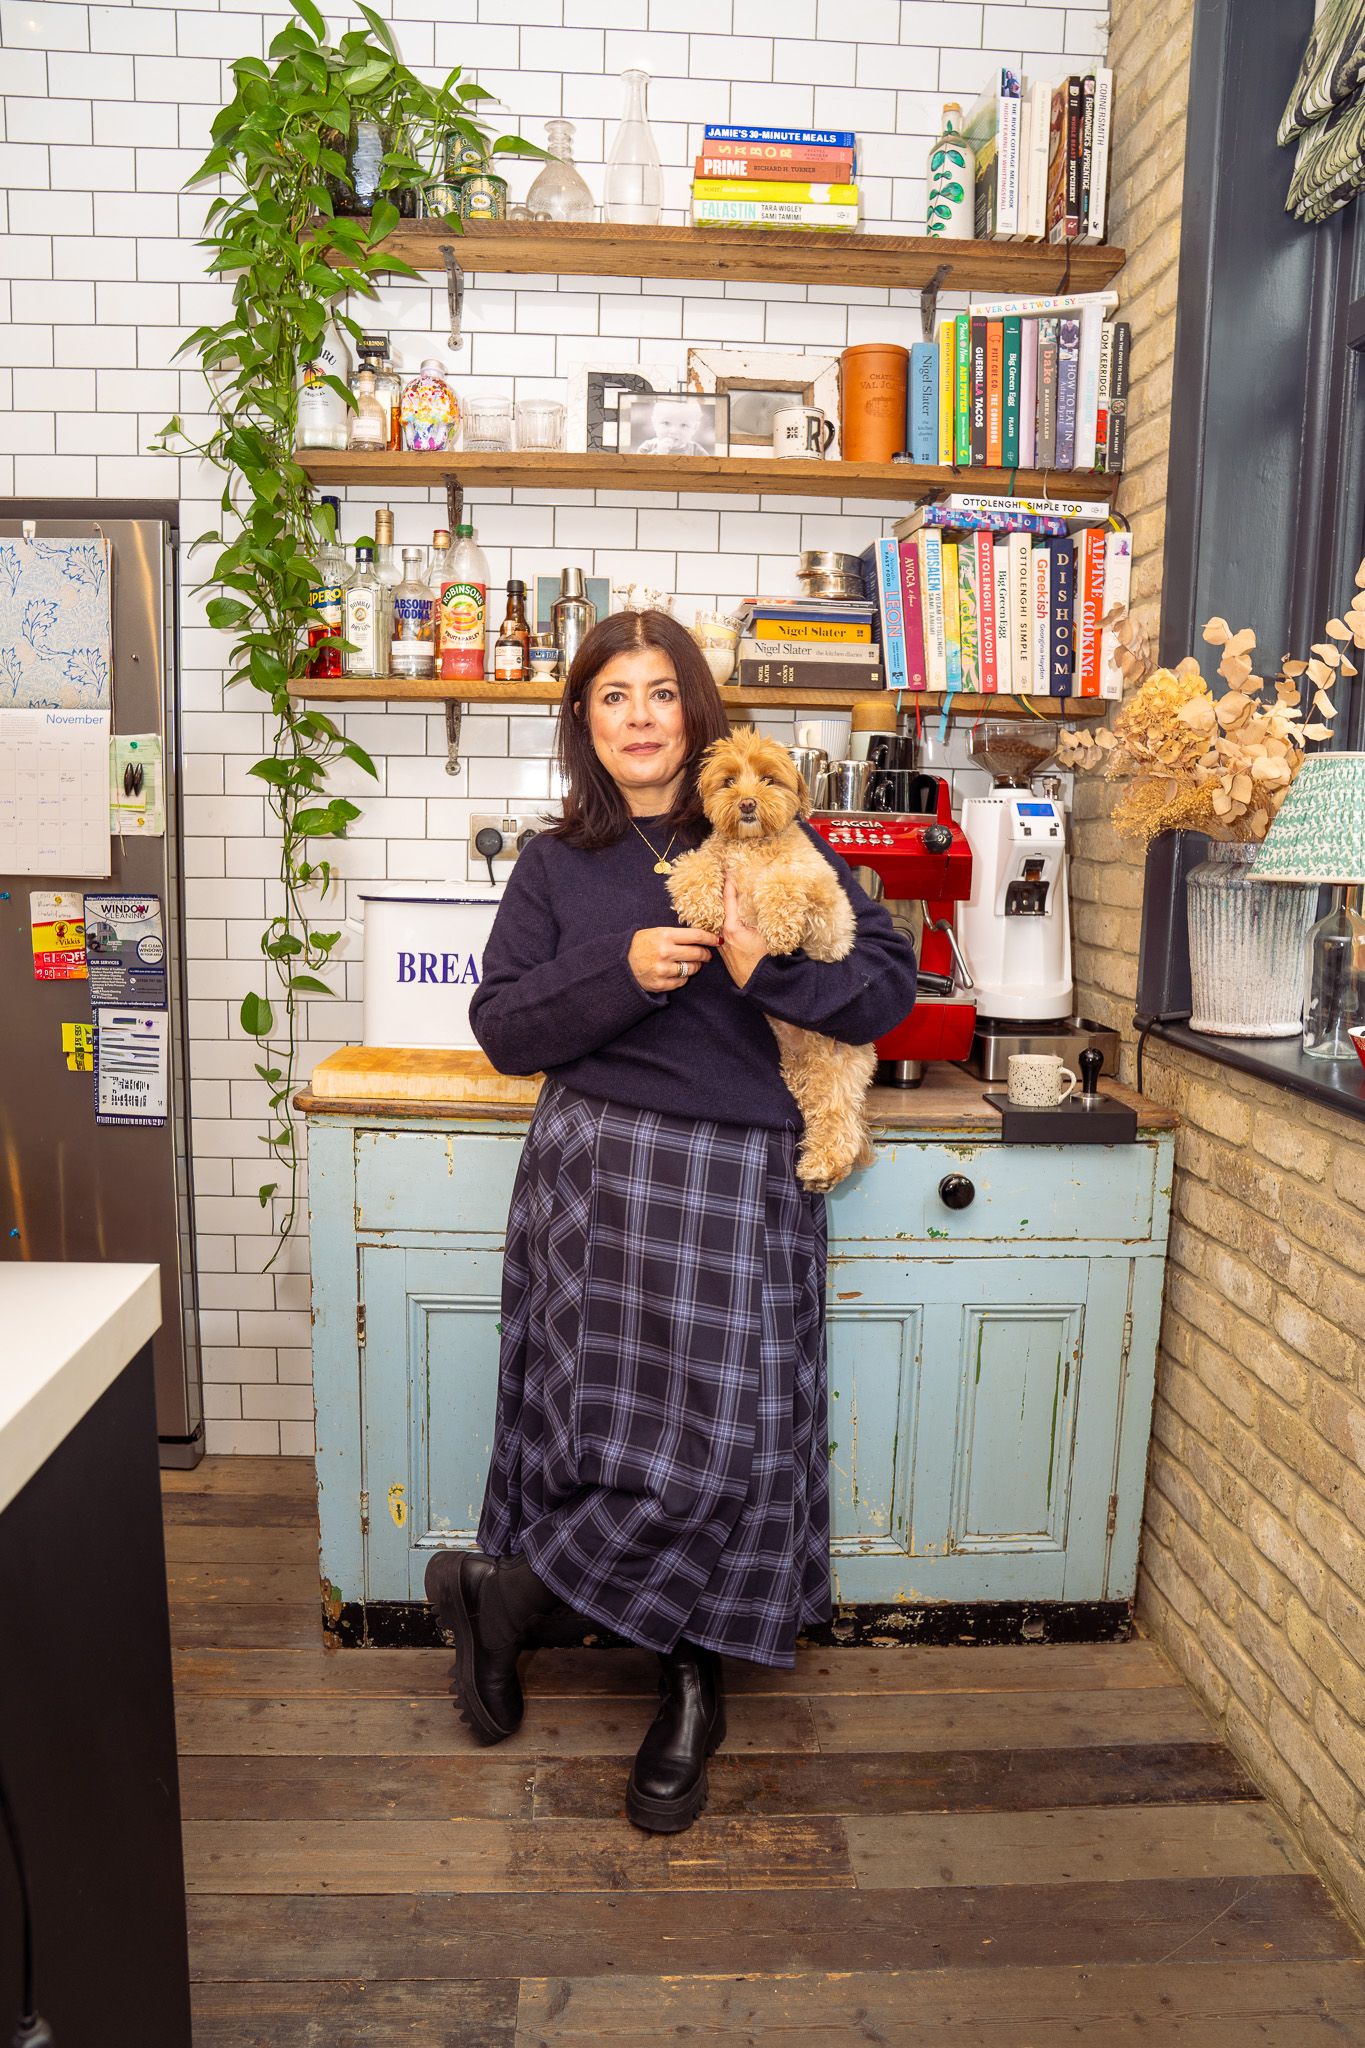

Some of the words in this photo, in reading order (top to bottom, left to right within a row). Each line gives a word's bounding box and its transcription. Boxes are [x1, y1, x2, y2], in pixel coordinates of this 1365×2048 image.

[1084, 97, 1093, 147] FISHMONGER'S
[1097, 83, 1108, 146] CORNERSMITH
[708, 128, 747, 138] JAMIE'S
[749, 129, 800, 141] 30-MINUTE
[802, 132, 836, 143] MEALS
[718, 145, 792, 159] SABOR
[703, 158, 748, 176] PRIME
[1082, 149, 1092, 190] APPRENTICE
[701, 202, 756, 219] FALASTIN
[1100, 330, 1109, 349] TOM
[920, 356, 932, 382] Nigel
[975, 347, 983, 395] GUERRILLA
[991, 365, 999, 378] CUE
[1007, 353, 1017, 365] Big
[1043, 350, 1054, 384] bake
[1066, 364, 1076, 391] HOW
[1099, 353, 1109, 397] KERRIDGE
[922, 386, 932, 416] Slater
[975, 397, 983, 428] TACOS
[991, 394, 999, 406] THE
[1007, 392, 1016, 407] Egg
[1066, 393, 1075, 407] TO
[990, 408, 998, 444] COOKBOOK
[1065, 409, 1074, 427] EAT
[806, 415, 820, 452] R
[1064, 430, 1073, 441] IN
[962, 498, 1021, 509] OTTOLENGHI
[1027, 501, 1060, 512] SIMPLE
[1062, 504, 1082, 513] TOO
[904, 557, 915, 588] AVOCA
[926, 539, 941, 591] JERUSALEM
[981, 543, 991, 611] OTTOLENGHI
[997, 570, 1007, 586] Big
[1091, 536, 1104, 598] ALPINE
[1019, 547, 1028, 617] OTTOLENGHI
[1036, 559, 1048, 619] Greekish
[394, 599, 433, 610] ABSOLUT
[442, 585, 482, 606] ROBINSONS
[999, 588, 1007, 618] Green
[398, 609, 430, 620] VODKA
[884, 591, 901, 637] LEON
[1054, 553, 1069, 675] DISHOOM
[445, 630, 457, 641] FRUIT
[778, 625, 807, 636] Nigel
[811, 626, 846, 637] Slater
[984, 617, 993, 664] FLAVOUR
[998, 620, 1008, 639] Egg
[1019, 623, 1028, 661] SIMPLE
[1038, 624, 1046, 653] Georgina
[1081, 601, 1096, 677] COOKING
[754, 642, 780, 656] Nigel
[783, 644, 812, 655] Slater
[825, 649, 844, 657] kitchen
[1038, 655, 1046, 679] Hayden
[47, 713, 104, 725] November
[831, 820, 883, 828] GAGGIA
[396, 952, 480, 984] BREA
